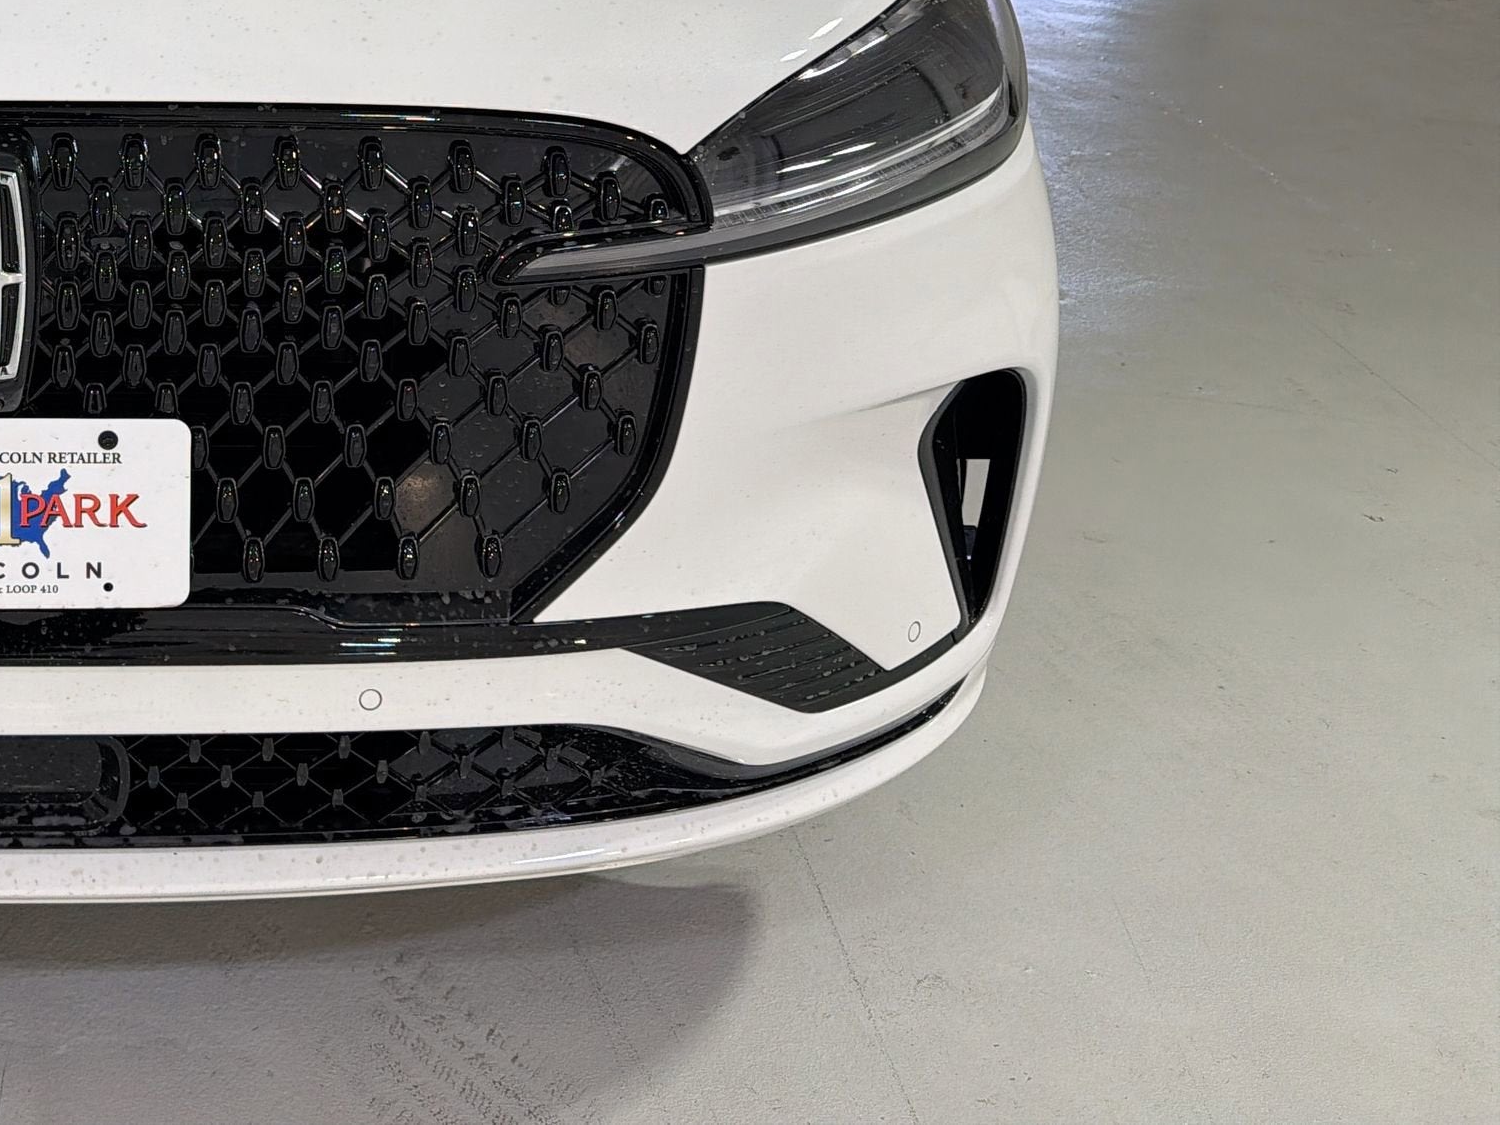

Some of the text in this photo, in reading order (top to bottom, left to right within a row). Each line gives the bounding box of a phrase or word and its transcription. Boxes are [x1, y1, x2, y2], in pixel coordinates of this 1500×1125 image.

[47, 451, 123, 465] RETAILER
[20, 493, 148, 529] PARK
[6, 585, 37, 594] LOOP
[40, 584, 59, 594] 410
